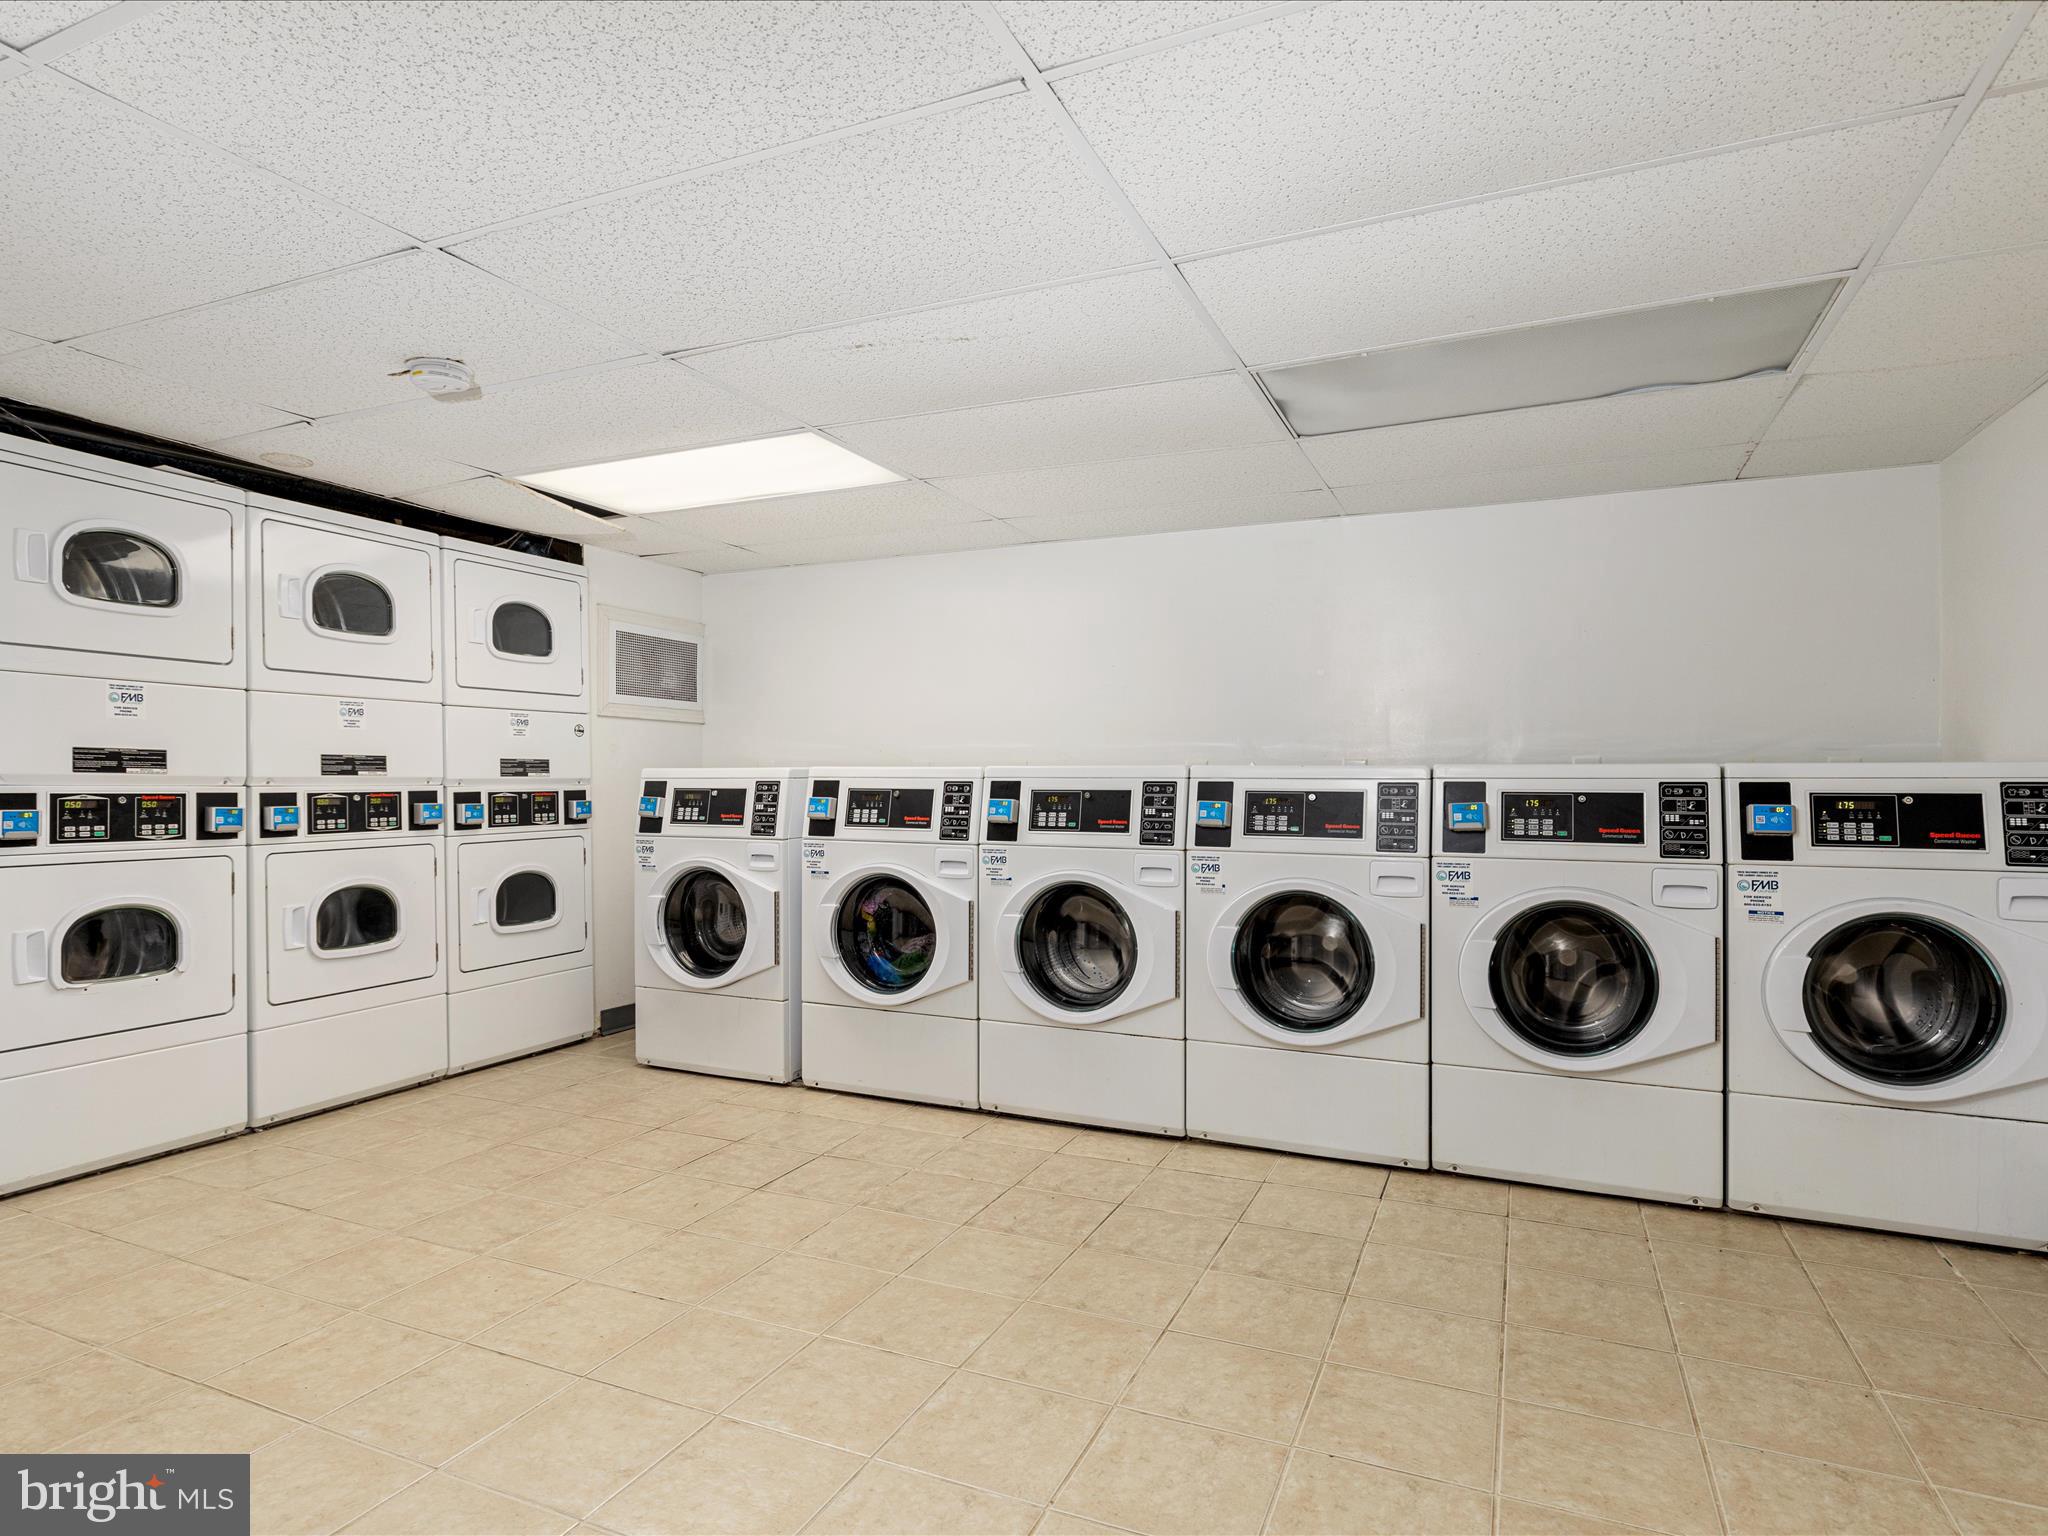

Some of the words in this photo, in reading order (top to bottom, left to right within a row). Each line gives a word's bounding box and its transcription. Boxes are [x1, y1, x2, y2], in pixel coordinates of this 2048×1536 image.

[120, 692, 144, 704] FMB
[1929, 831, 1955, 839] Speed
[1955, 831, 1981, 839] Queen
[990, 855, 1007, 865] FMB
[1200, 863, 1221, 873] FMB
[1448, 870, 1471, 882] FMB
[1751, 879, 1779, 892] FMB
